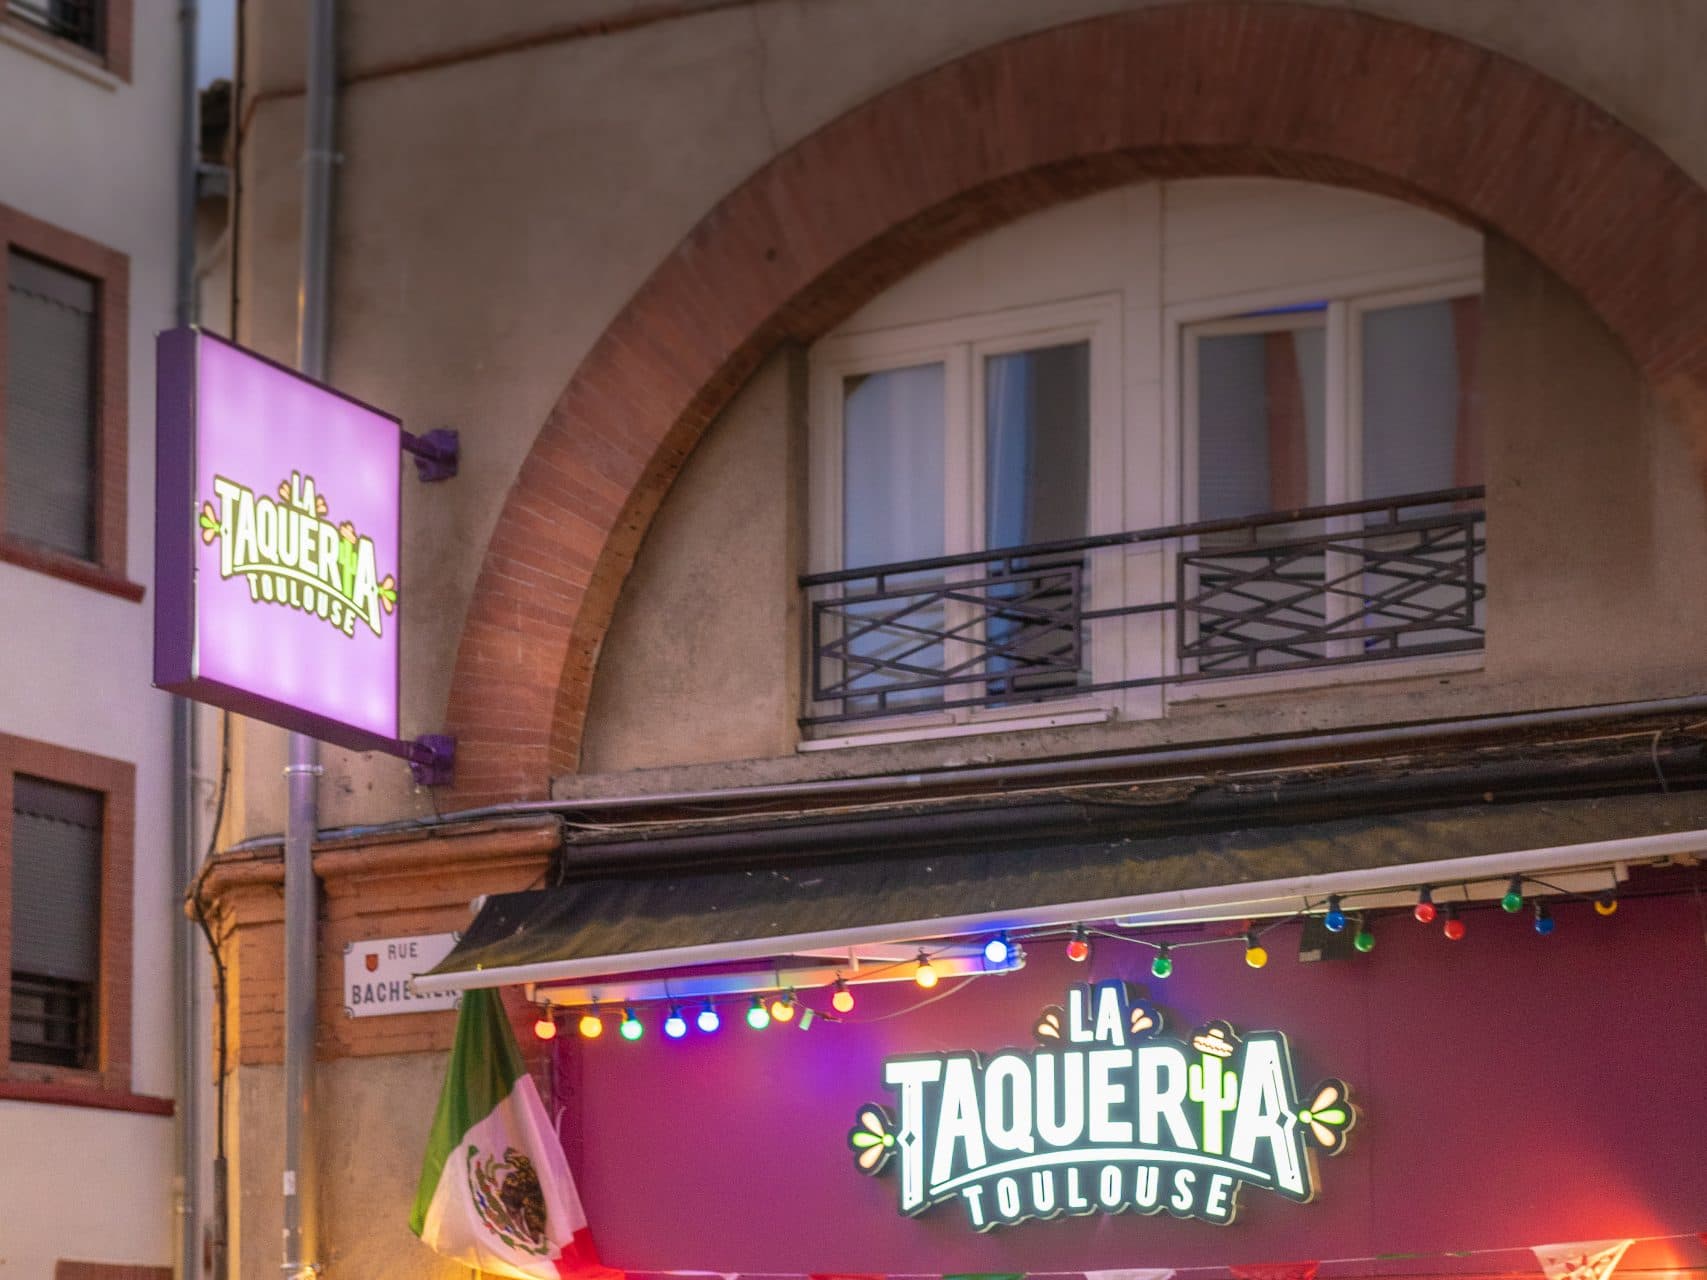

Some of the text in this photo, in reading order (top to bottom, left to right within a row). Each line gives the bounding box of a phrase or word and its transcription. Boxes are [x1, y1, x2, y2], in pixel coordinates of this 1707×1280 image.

[291, 473, 317, 518] LA
[247, 572, 357, 636] TOULOUSE
[387, 942, 419, 961] RUE
[352, 980, 457, 1005] BACHE
[1068, 986, 1125, 1046] LA
[962, 1164, 1237, 1226] TOULOUSE
